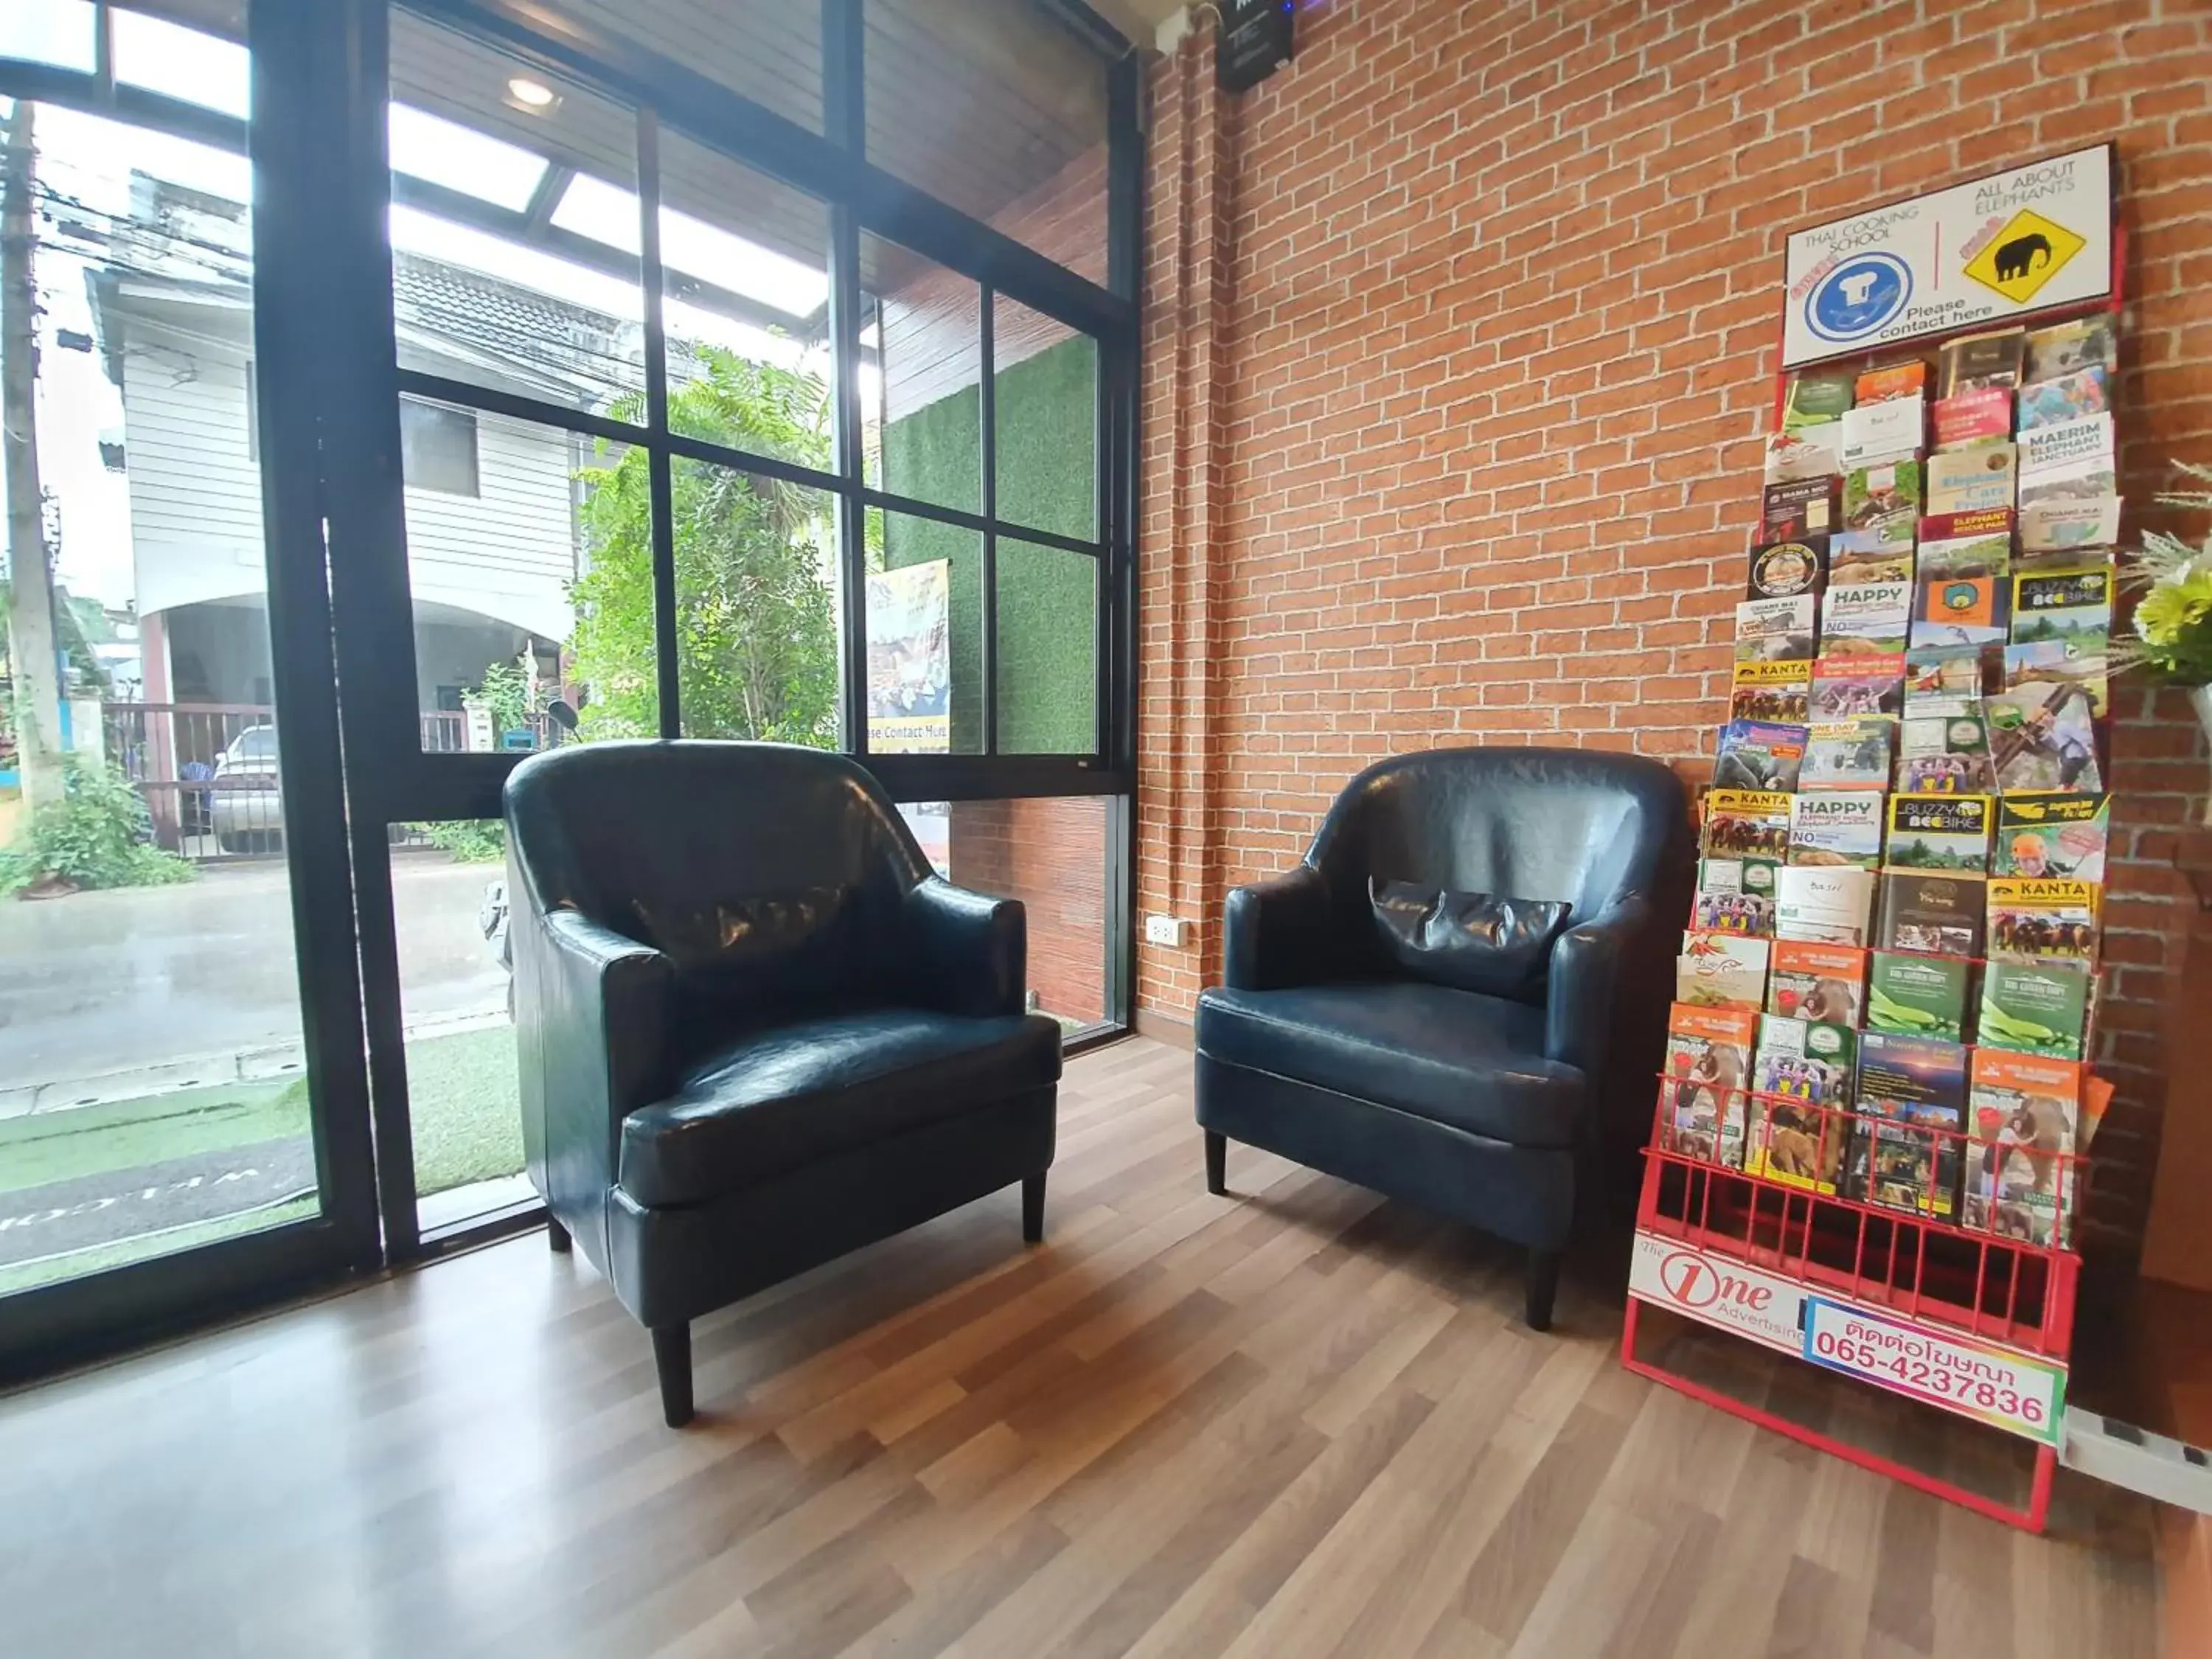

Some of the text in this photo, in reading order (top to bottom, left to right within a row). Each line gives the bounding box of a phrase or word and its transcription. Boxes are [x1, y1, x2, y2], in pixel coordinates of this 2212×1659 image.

[1975, 161, 2075, 201] ALL ABOUT
[1975, 180, 2075, 215] ELEPHANTS
[1805, 206, 1919, 248] THAI COOKING
[1829, 229, 1894, 254] SCHOOL
[1907, 299, 1966, 320] Please
[1880, 306, 1993, 339] contact here
[2030, 422, 2100, 447] MAERIM
[2030, 434, 2099, 456] ELEPHANT
[1834, 588, 1902, 603] HAPPY
[1760, 662, 1807, 675] KANTA
[885, 726, 923, 739] Contact
[1741, 793, 1789, 806] KANTA
[1799, 801, 1871, 814] HAPPY
[1901, 802, 1956, 815] BUZZY
[1792, 832, 1815, 843] NO
[2020, 882, 2086, 894] KANTA
[1816, 1331, 2044, 1423] 065-4237836
